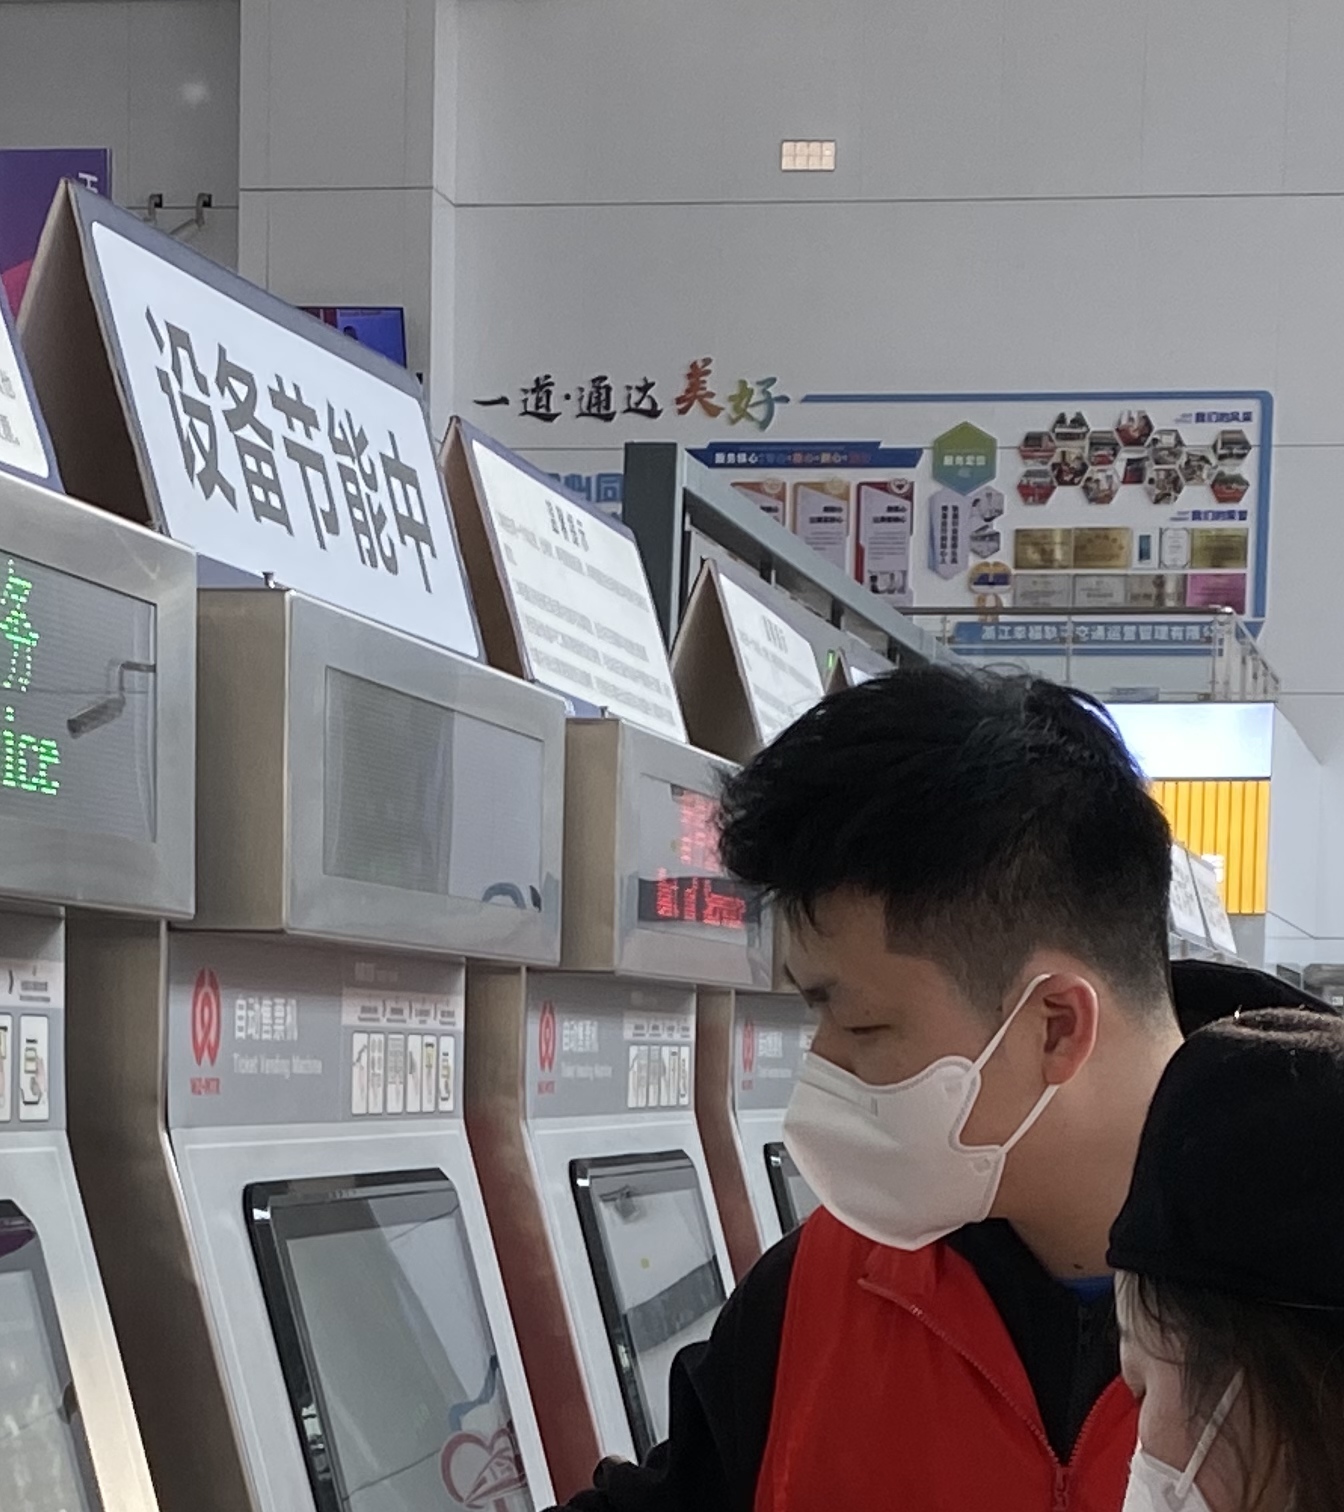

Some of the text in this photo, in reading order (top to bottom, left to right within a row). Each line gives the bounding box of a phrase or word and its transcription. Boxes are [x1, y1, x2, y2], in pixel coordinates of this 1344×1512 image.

[145, 306, 438, 594] 设备节能中
